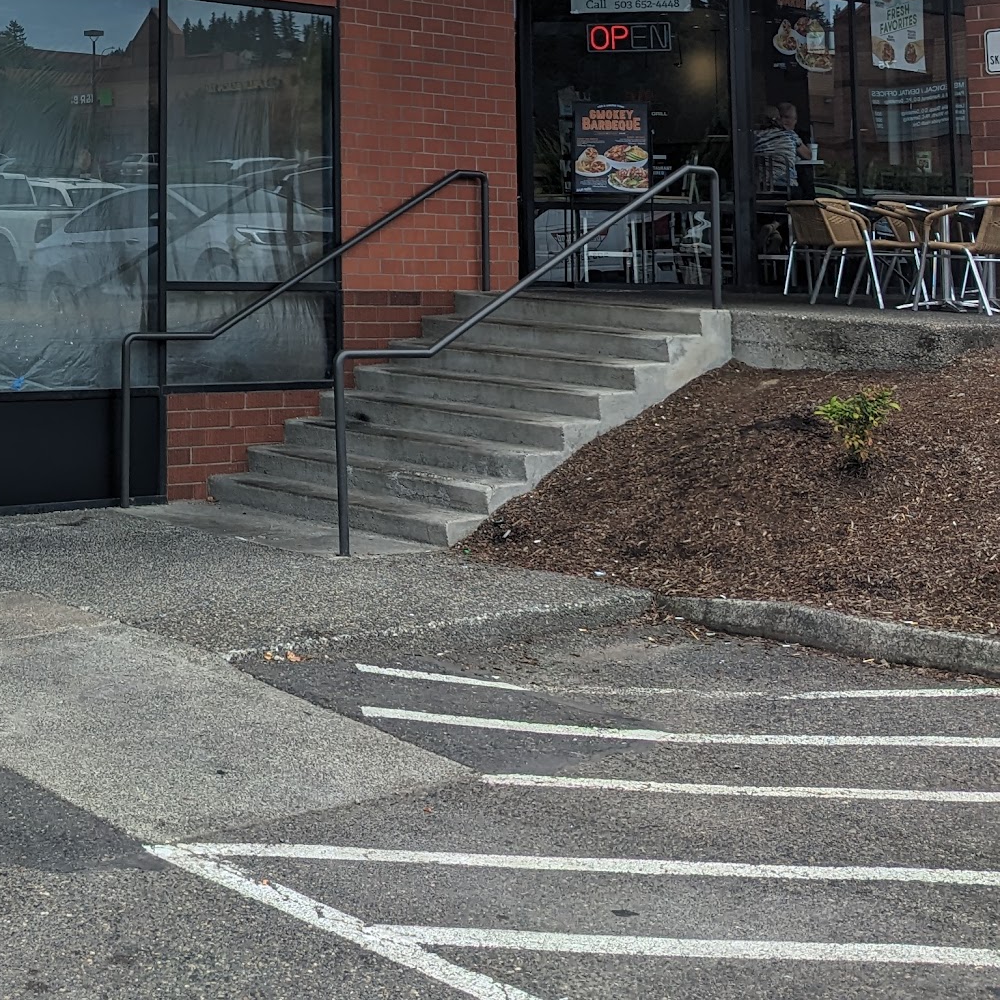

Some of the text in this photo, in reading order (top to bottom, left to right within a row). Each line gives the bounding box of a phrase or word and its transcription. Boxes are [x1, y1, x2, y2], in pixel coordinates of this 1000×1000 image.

[585, 0, 680, 10] Call 503 652-4448
[886, 3, 910, 21] FRESH
[879, 13, 918, 35] FAVORITES
[590, 24, 668, 51] OPEN
[589, 109, 634, 120] SMOKEY
[581, 116, 642, 131] BARBEQUE
